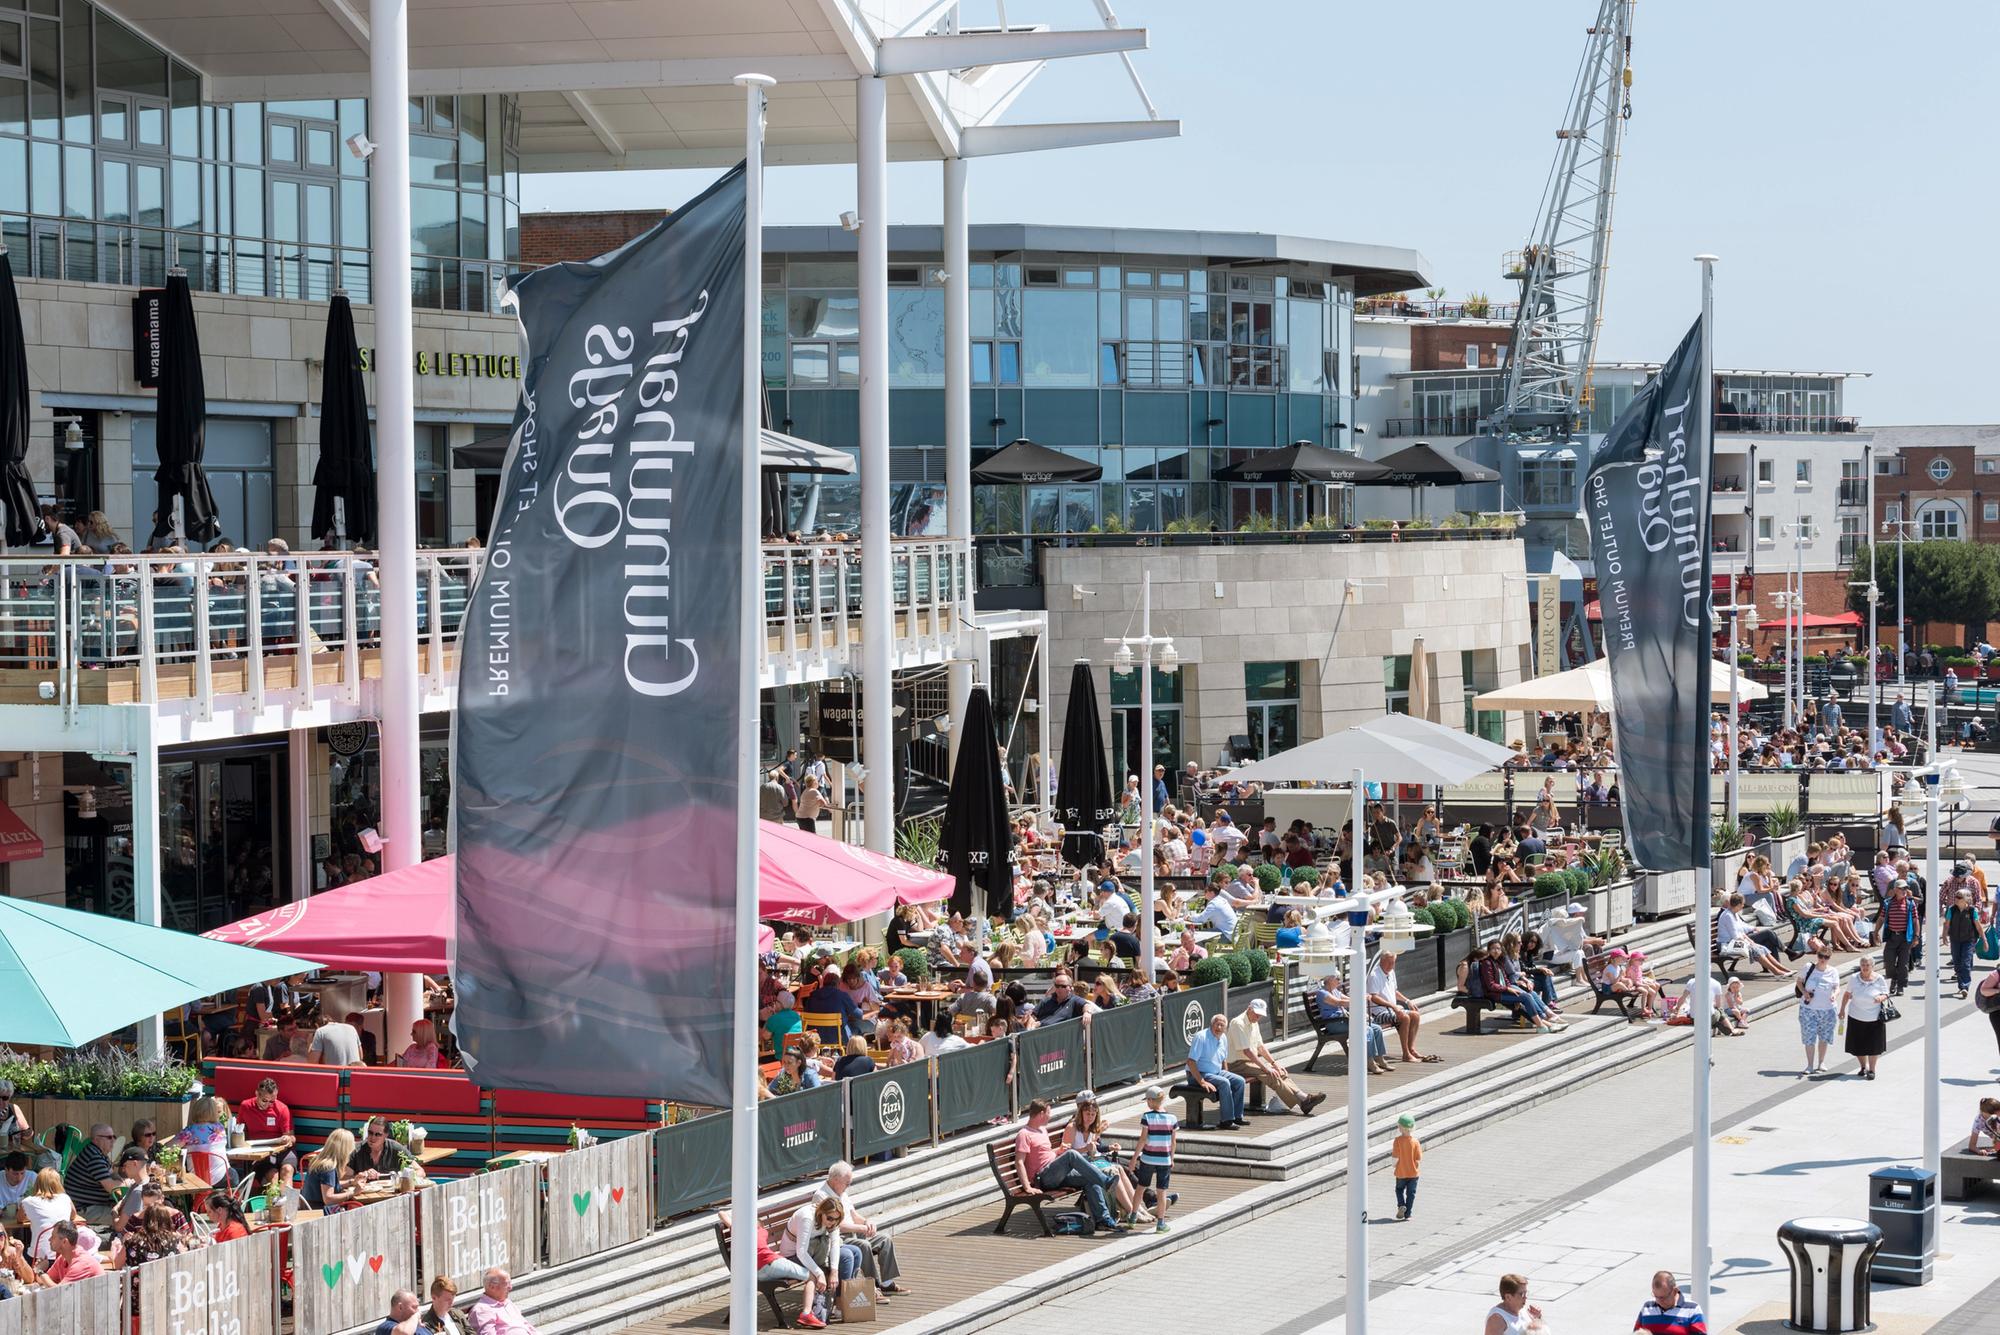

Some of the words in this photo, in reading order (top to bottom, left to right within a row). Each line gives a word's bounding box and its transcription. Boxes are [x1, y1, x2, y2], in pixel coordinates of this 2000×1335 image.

[435, 352, 521, 378] LETTUCE
[1543, 587, 1555, 621] ONE
[1543, 628, 1554, 657] BAR
[883, 1099, 901, 1116] Zizzi
[449, 1187, 507, 1236] Bella
[451, 1232, 510, 1279] Italia
[171, 1260, 241, 1316] Bella
